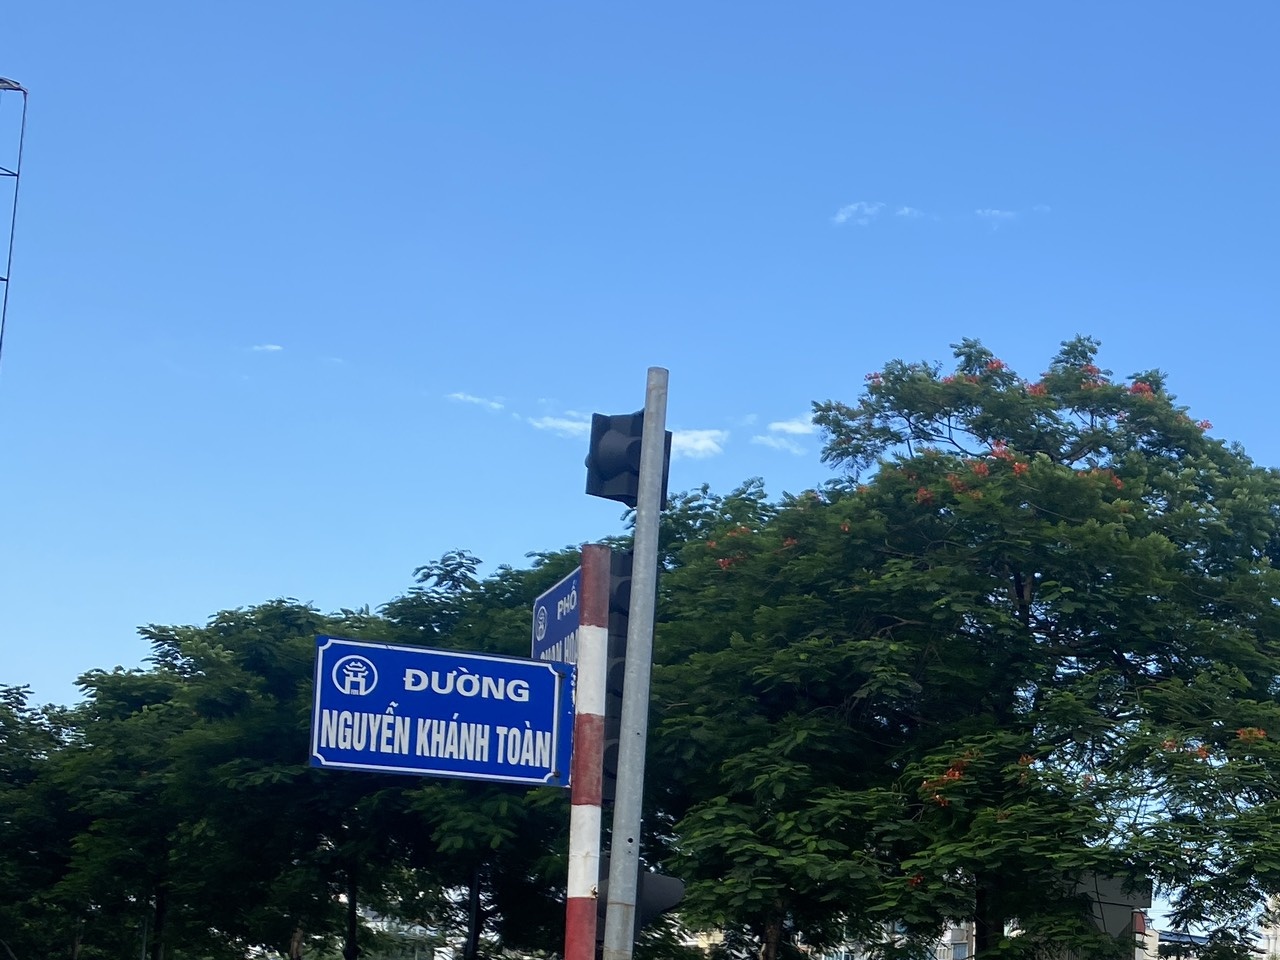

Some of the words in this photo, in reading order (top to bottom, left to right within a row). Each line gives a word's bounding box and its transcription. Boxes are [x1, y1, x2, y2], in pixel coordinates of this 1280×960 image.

[557, 580, 577, 620] PHỐ
[403, 666, 530, 702] ĐƯỜNG
[320, 701, 411, 755] NGUYỄN
[415, 713, 490, 762] KHÁNH
[496, 721, 551, 768] TOÀN
